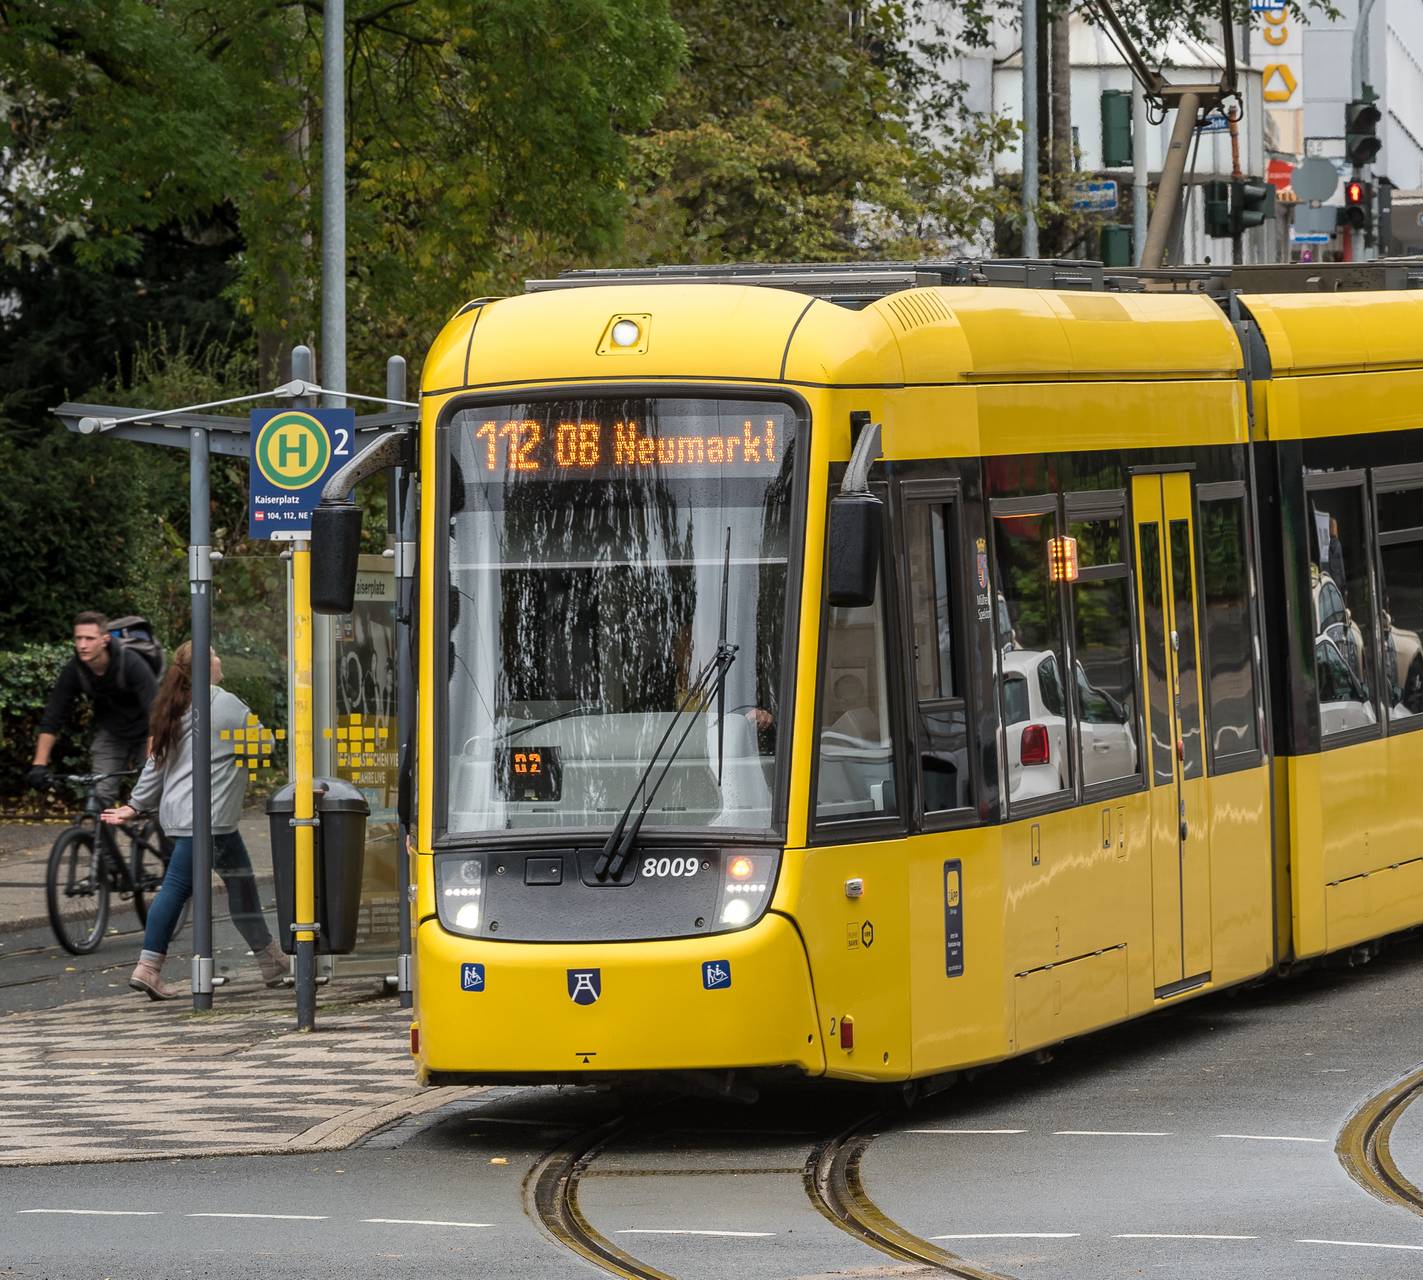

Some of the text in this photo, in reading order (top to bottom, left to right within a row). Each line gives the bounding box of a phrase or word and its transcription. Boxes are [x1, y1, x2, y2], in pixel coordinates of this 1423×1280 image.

[279, 433, 307, 468] H
[333, 428, 349, 455] 2
[476, 420, 541, 471] 112
[613, 419, 777, 466] Neumarkt
[254, 494, 300, 506] Kaiserplatz
[267, 511, 282, 521] 104,
[283, 511, 297, 521] 112,
[298, 511, 309, 520] NE
[356, 579, 385, 598] aiserplatz
[390, 752, 399, 767] VIE
[514, 753, 541, 773] 02
[641, 857, 699, 877] 8009
[830, 1016, 836, 1037] 2
